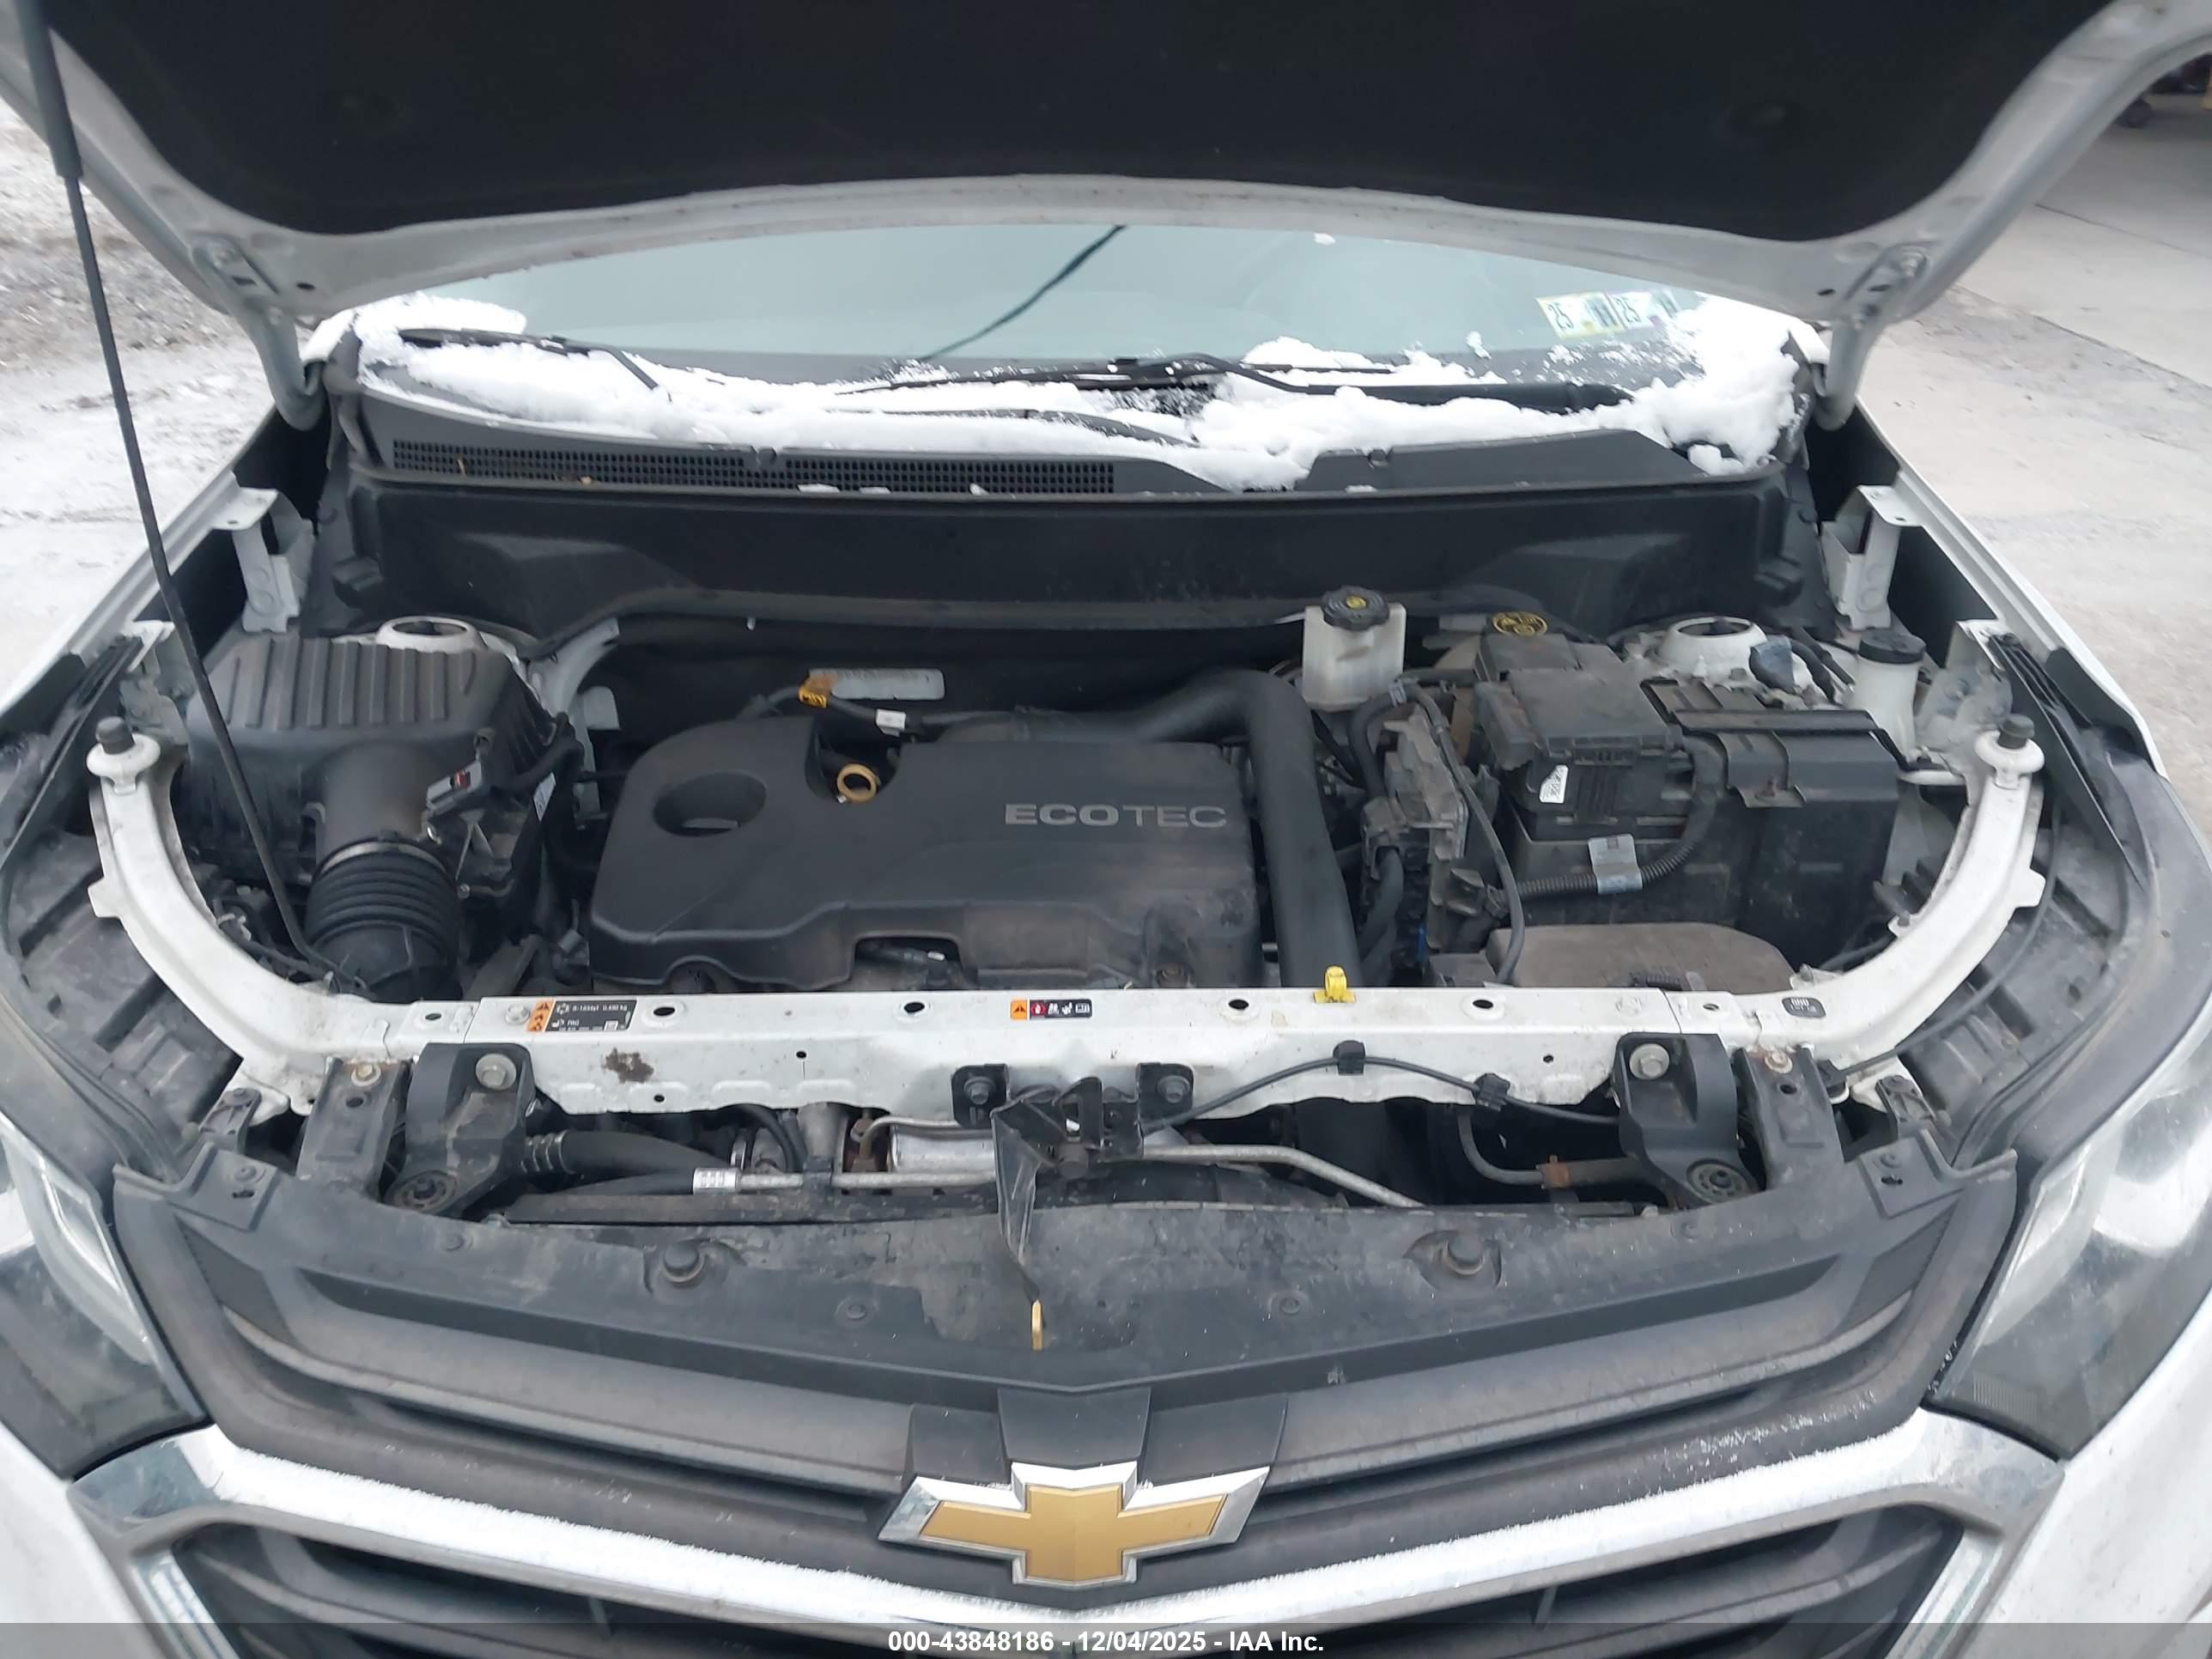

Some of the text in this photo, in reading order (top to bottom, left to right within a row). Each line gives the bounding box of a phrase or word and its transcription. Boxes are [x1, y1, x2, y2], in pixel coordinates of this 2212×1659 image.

[1547, 301, 1575, 331] 25
[1616, 296, 1642, 324] 25
[1004, 803, 1228, 829] ECOTEC
